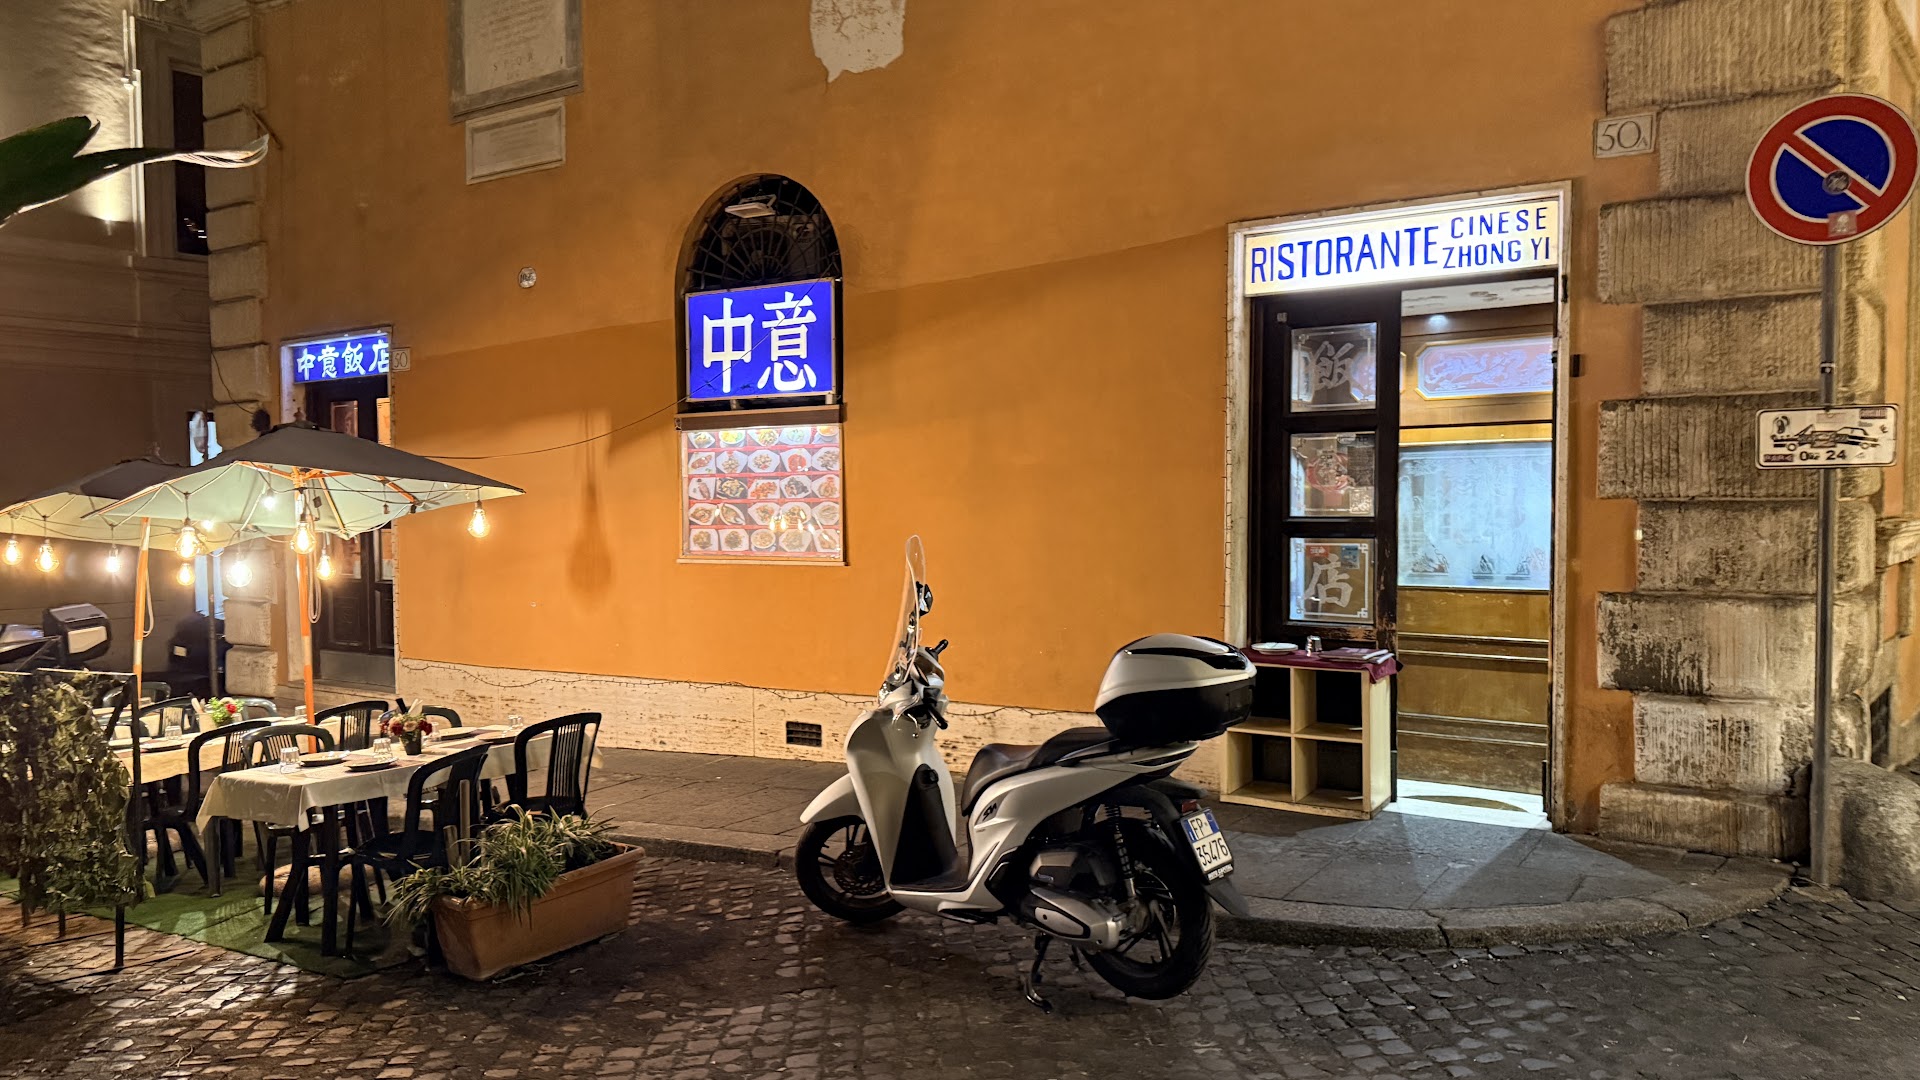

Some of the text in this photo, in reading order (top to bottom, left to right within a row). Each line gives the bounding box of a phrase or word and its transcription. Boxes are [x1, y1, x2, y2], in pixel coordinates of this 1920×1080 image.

[1450, 207, 1549, 239] CINESE
[1250, 226, 1439, 284] RISTORANTE
[1442, 236, 1551, 269] ZHONG YI
[297, 339, 389, 380] 中意飯店
[394, 350, 408, 369] 50
[703, 291, 817, 393] 中意
[1313, 341, 1354, 389] 飯
[1825, 450, 1848, 462] 24
[1304, 553, 1353, 608] 店
[1196, 838, 1228, 867] 35476
